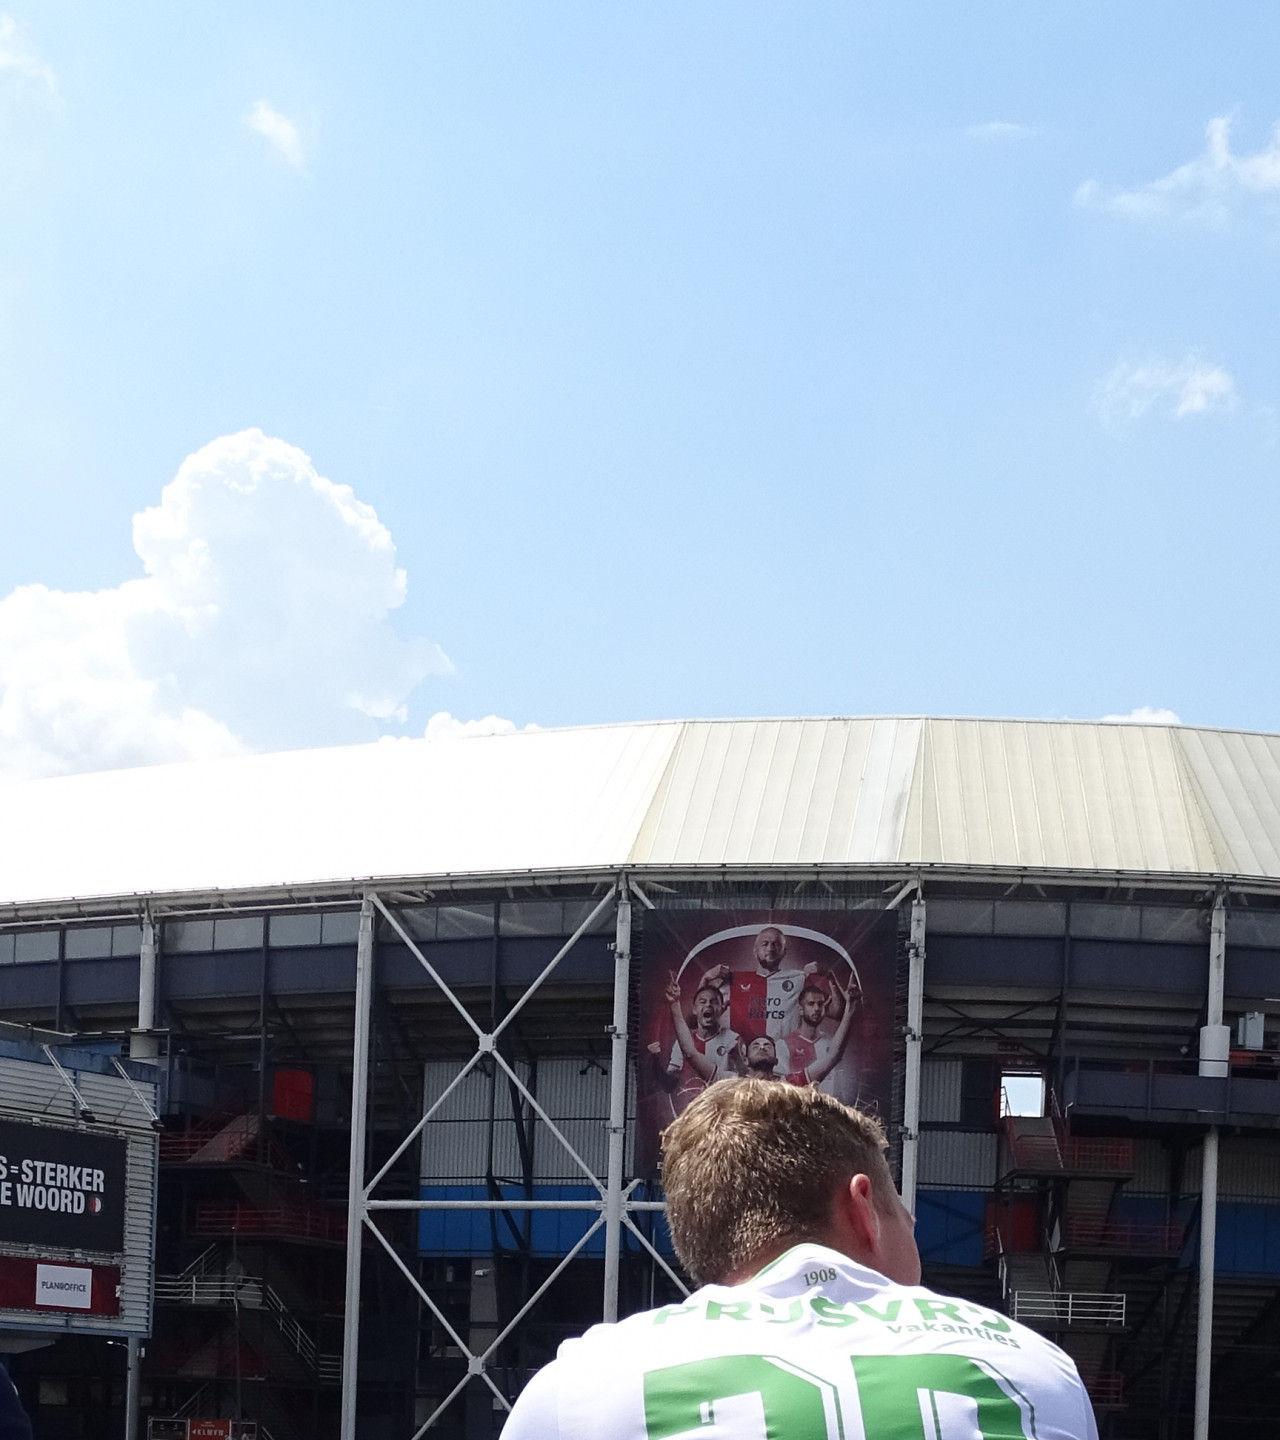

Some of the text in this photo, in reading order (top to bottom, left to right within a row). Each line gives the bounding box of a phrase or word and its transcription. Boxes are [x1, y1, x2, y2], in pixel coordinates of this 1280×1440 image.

[749, 1009, 786, 1020] Parcs
[21, 1159, 105, 1193] STERKER
[16, 1184, 85, 1214] WOORD
[803, 1267, 838, 1287] 1908
[886, 1322, 1023, 1350] vakanties
